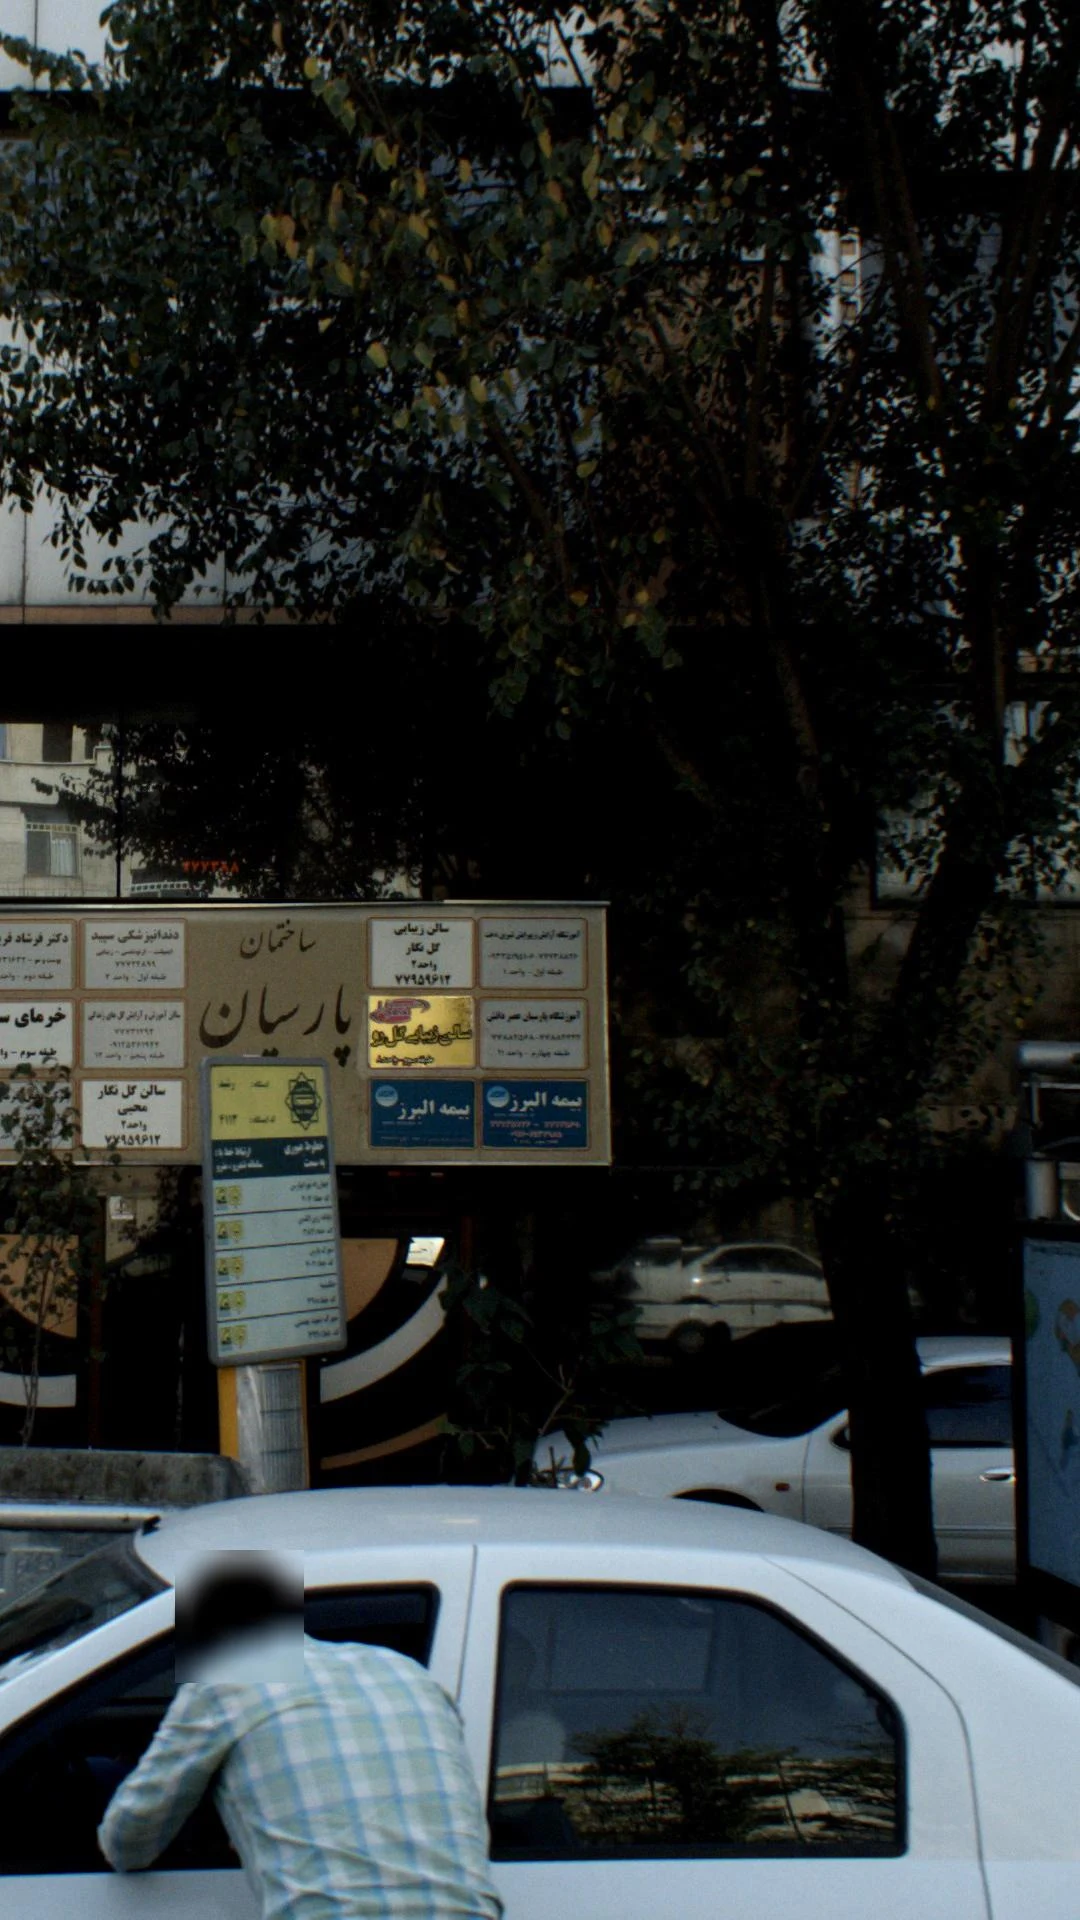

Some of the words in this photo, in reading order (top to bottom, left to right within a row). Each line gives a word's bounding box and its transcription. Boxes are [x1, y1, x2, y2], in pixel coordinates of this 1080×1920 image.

[240, 919, 318, 959] ساختمان
[199, 983, 352, 1068] پارسیان
[140, 1085, 166, 1099] سالن
[508, 1090, 547, 1113] البرز
[396, 1098, 436, 1121] البرز
[439, 1102, 471, 1121] بیمه
[551, 1095, 584, 1113] بیمه
